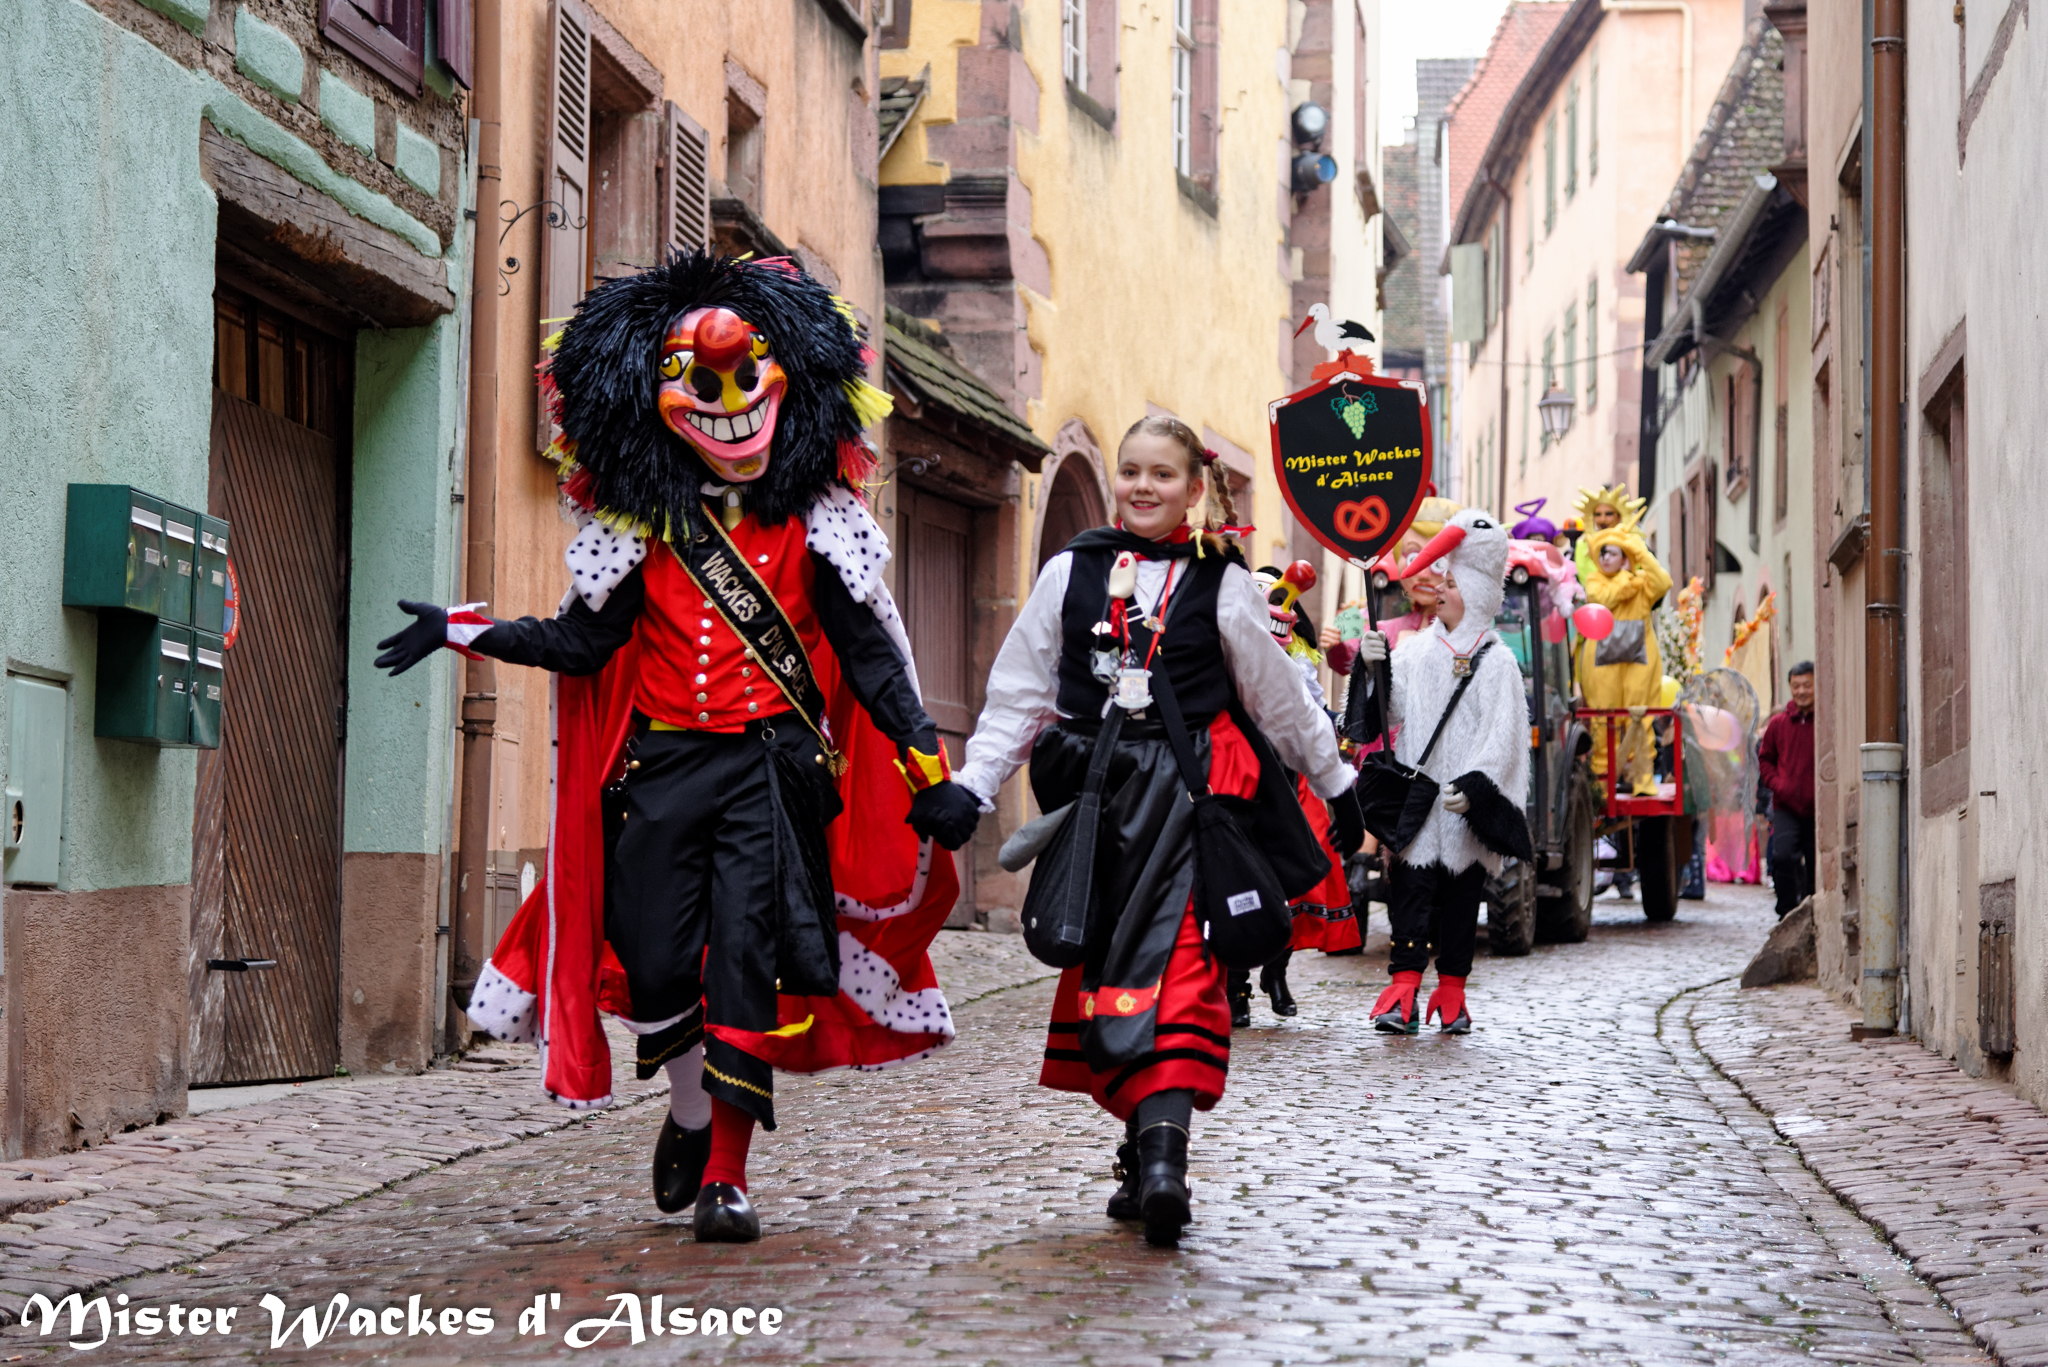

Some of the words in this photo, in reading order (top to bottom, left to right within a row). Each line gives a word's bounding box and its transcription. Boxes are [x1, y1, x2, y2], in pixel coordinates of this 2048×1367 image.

[1285, 455, 1347, 473] Mister
[1353, 446, 1421, 467] Wackes
[701, 551, 762, 622] WACKES
[758, 624, 809, 701] D'ALSACE
